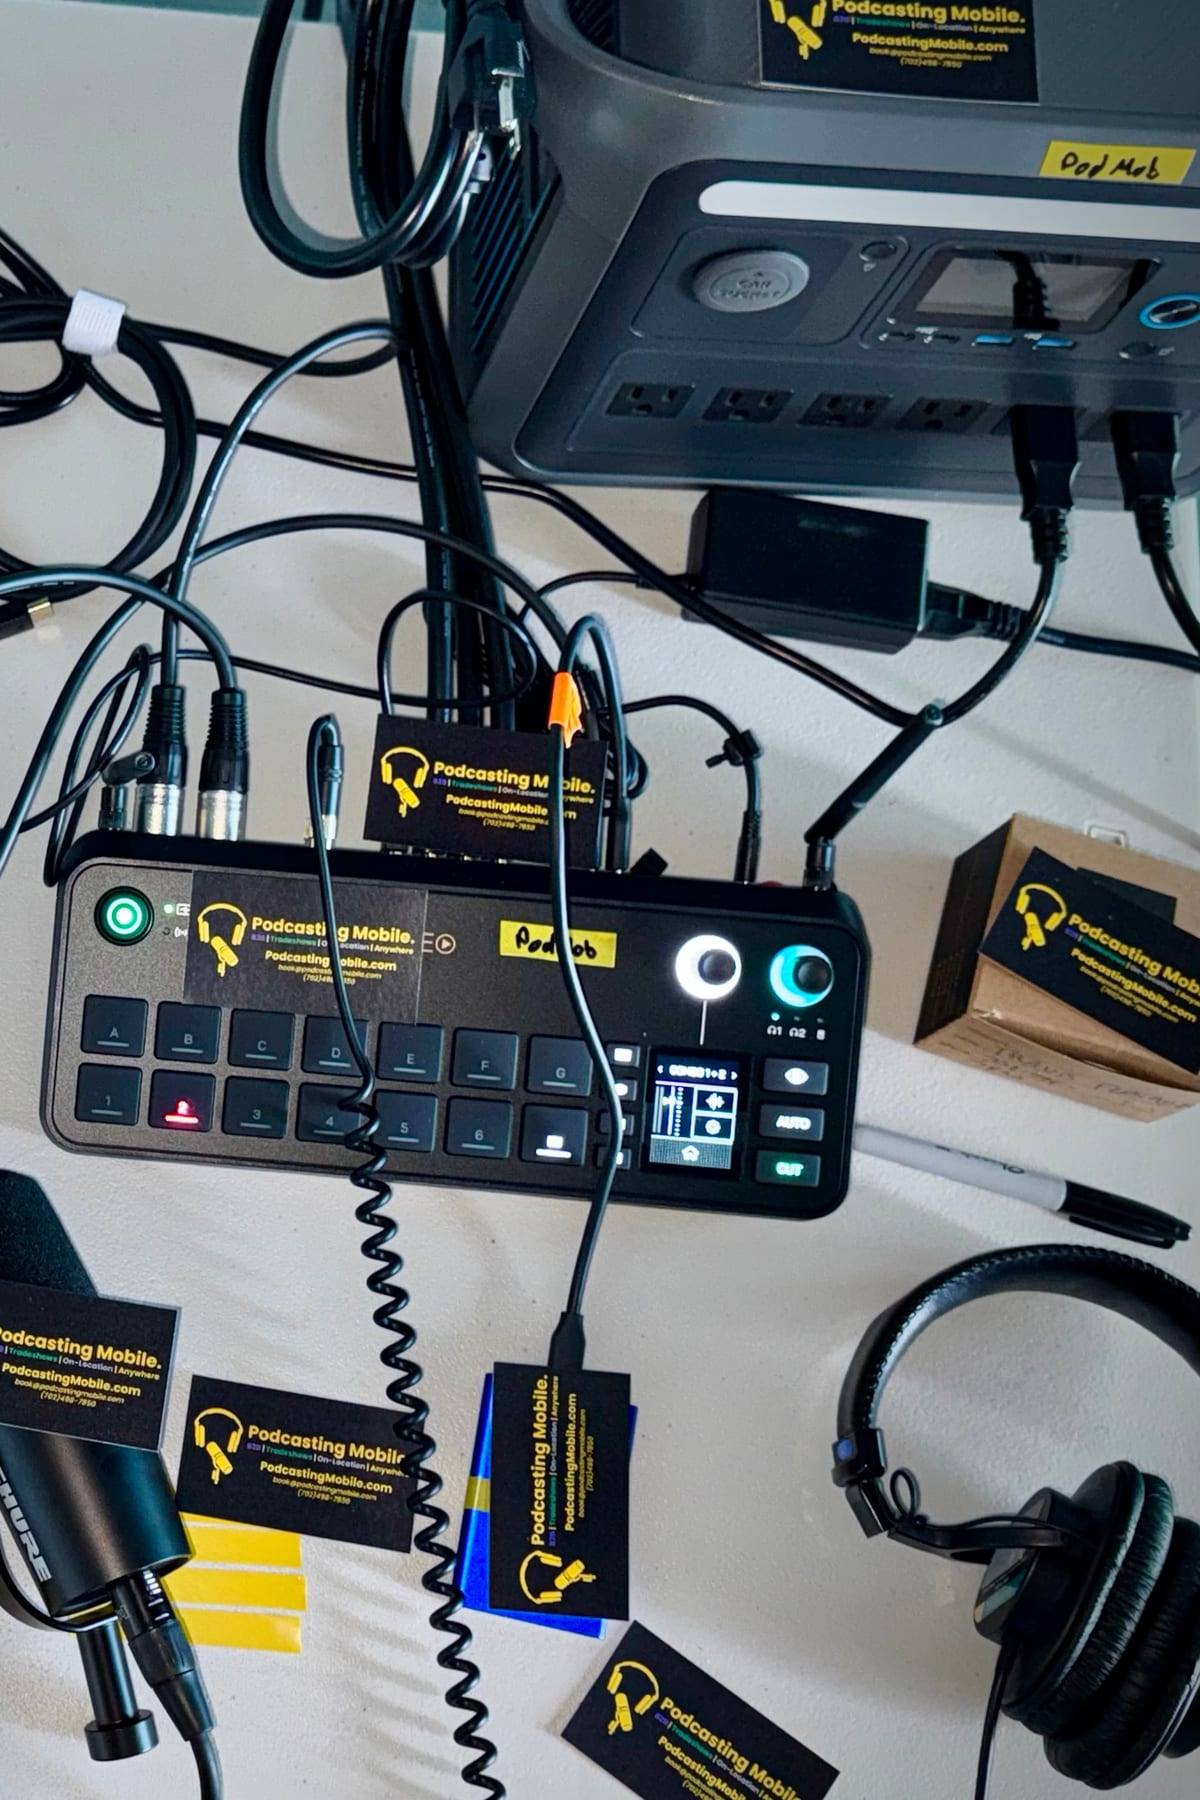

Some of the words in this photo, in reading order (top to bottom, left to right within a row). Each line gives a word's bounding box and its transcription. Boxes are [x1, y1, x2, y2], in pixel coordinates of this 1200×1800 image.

[832, 0, 947, 23] Podcasting
[950, 5, 1025, 24] Mobile.
[852, 32, 1008, 53] PodcastingMobile.com
[433, 761, 530, 790] Podcasting
[251, 916, 349, 943] Podcastig
[352, 925, 415, 944] Mobile.
[1068, 913, 1162, 976] Podcasting
[264, 950, 397, 971] Podcastingobile.com
[1071, 947, 1196, 1023] PodcastingMobile.com
[109, 1027, 119, 1038] A
[183, 1033, 193, 1045] B
[257, 1040, 267, 1052] C
[331, 1047, 341, 1059] D
[406, 1053, 415, 1065] E
[480, 1060, 489, 1071] F
[555, 1067, 566, 1079] G
[96, 1344, 161, 1369] Mobile.
[1, 1362, 141, 1396] PodcastingMobile.com
[531, 1374, 547, 1439] Mobile.
[248, 1424, 346, 1459] Podcasting
[564, 1393, 579, 1531] PodcastingMobile.com
[259, 1460, 393, 1494] PodcastingMobile.com
[530, 1442, 551, 1545] Podcasting
[659, 1696, 750, 1773] Podcasting
